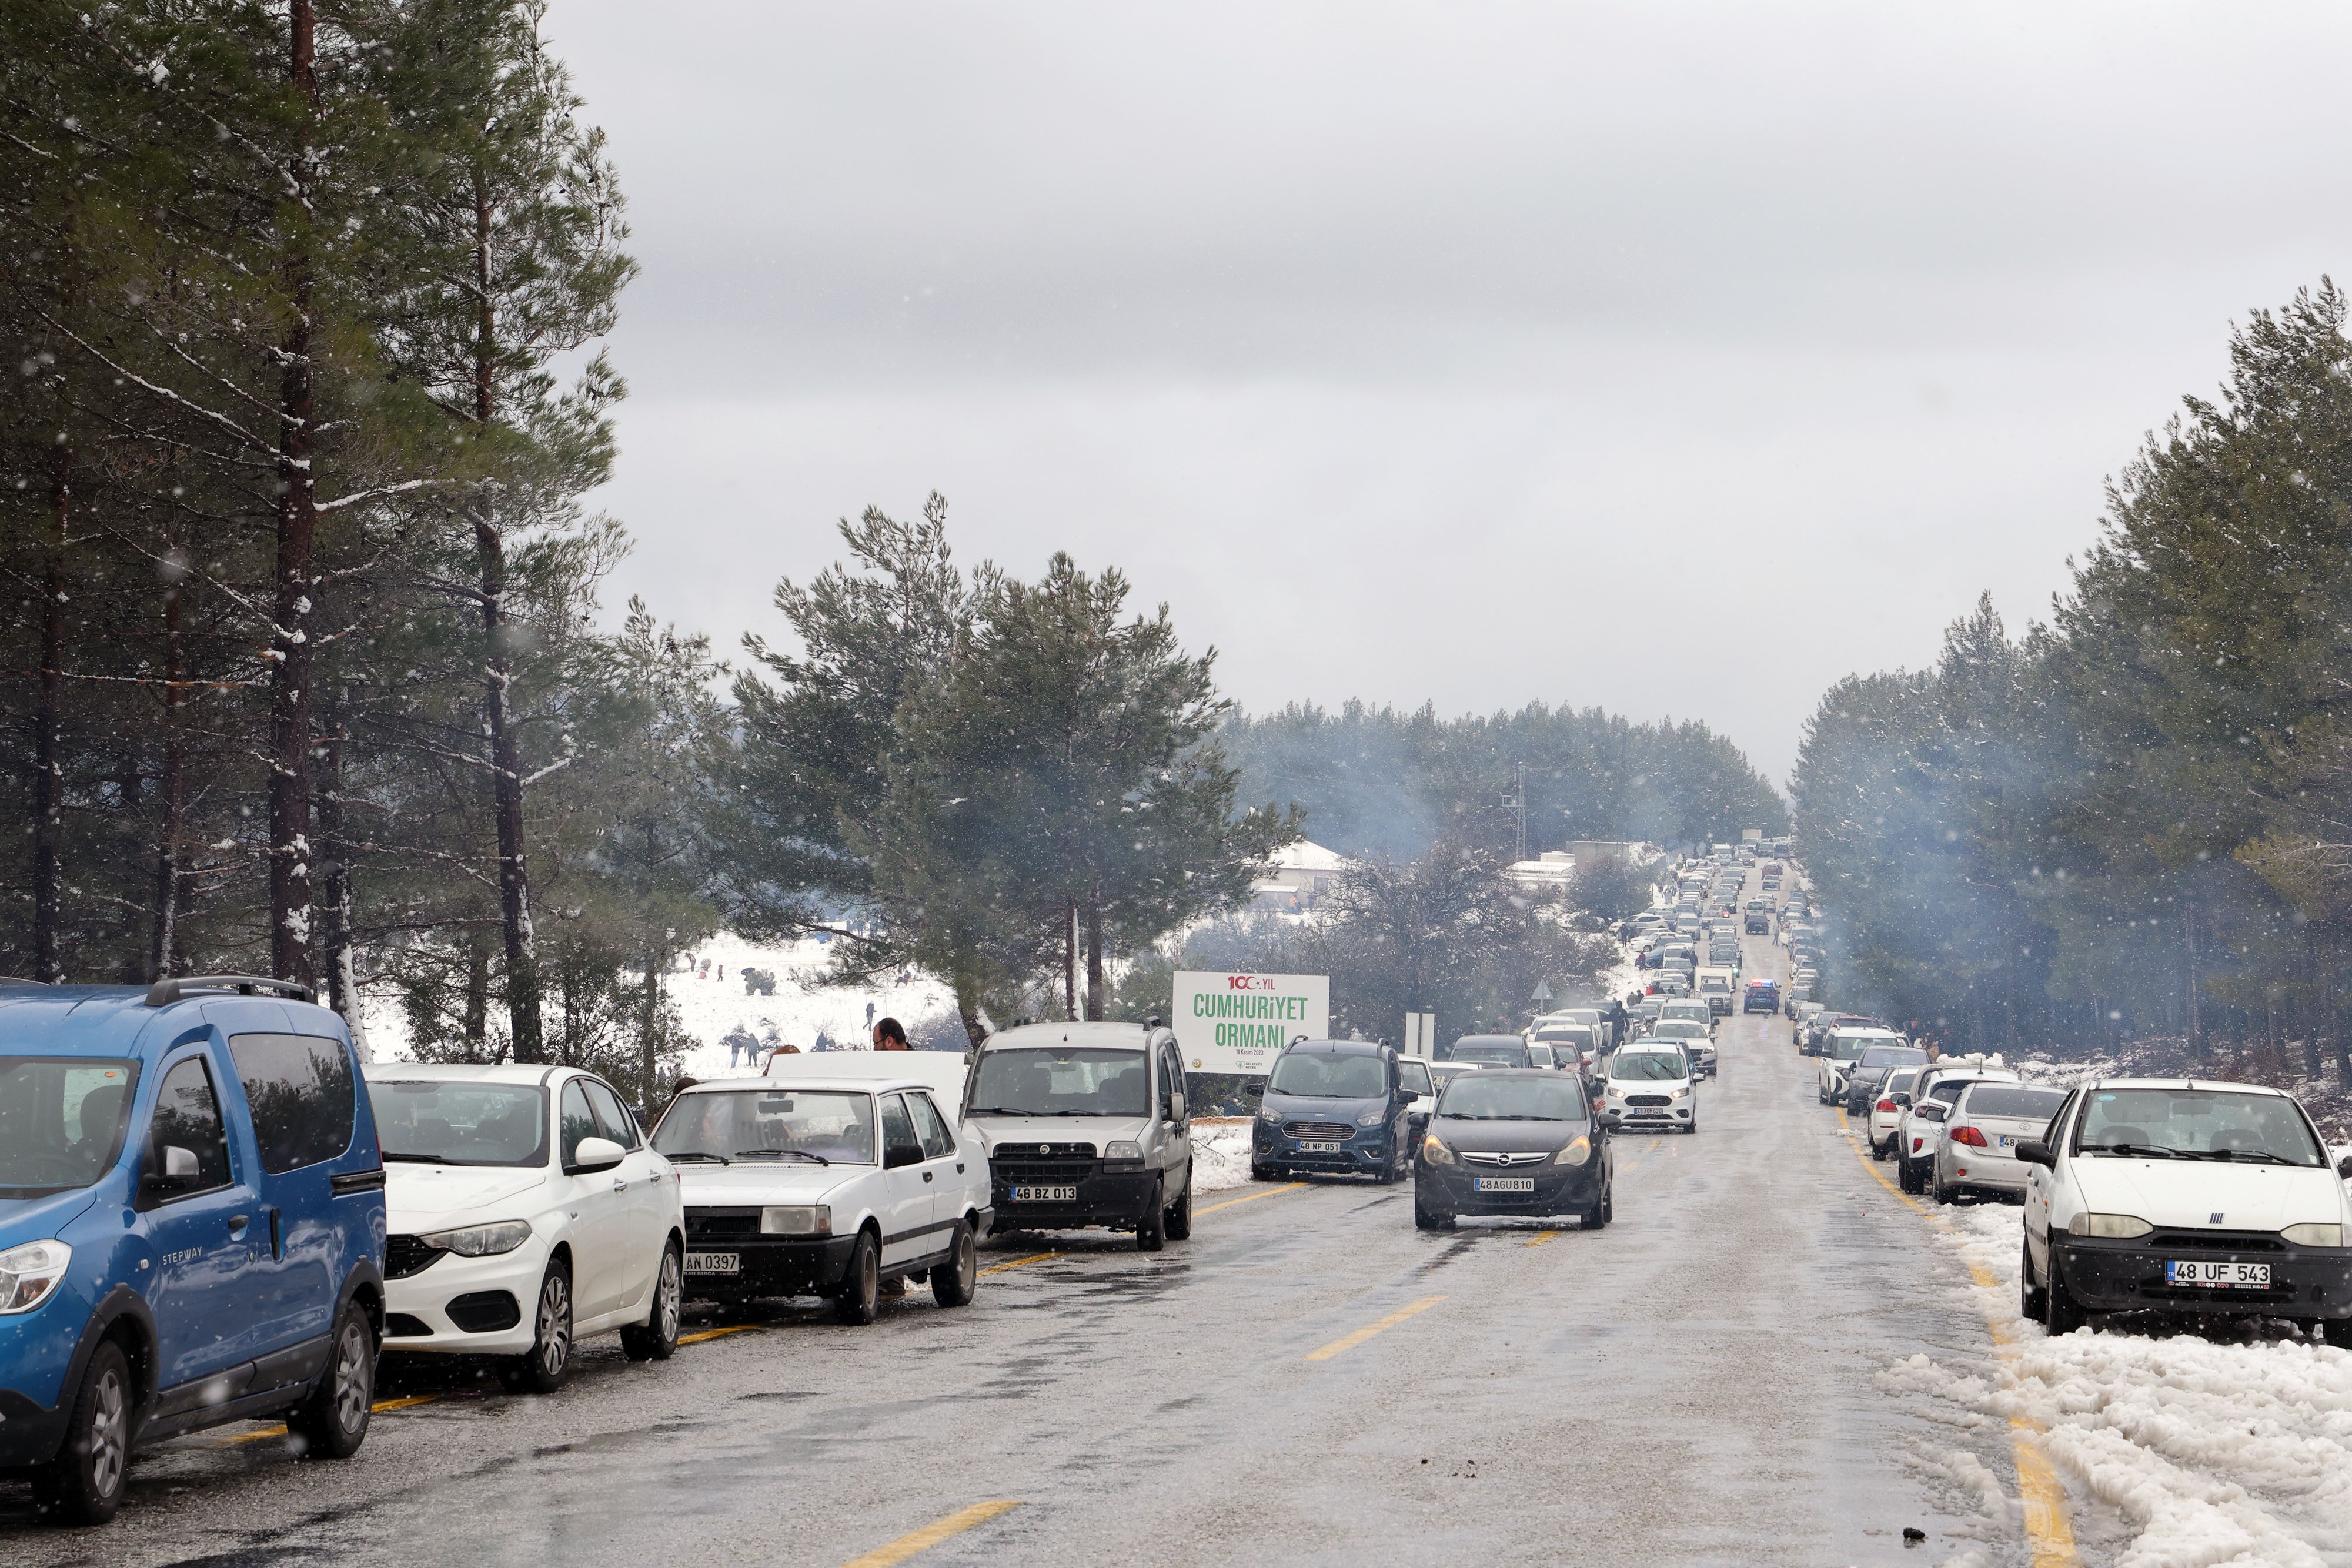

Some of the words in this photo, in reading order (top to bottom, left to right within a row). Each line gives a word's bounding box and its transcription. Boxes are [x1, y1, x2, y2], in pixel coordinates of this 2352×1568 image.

[1215, 1022, 1285, 1048] ORMANI
[2004, 1138, 2015, 1146] 48
[1016, 1188, 1030, 1199] 48
[1035, 1188, 1049, 1199] BZ
[1054, 1188, 1075, 1199] 013
[162, 1246, 202, 1265] STEPWAY
[686, 1256, 701, 1269] AN
[706, 1255, 737, 1269] 0397
[2177, 1263, 2196, 1279] 48
[2205, 1264, 2229, 1280] UF
[2237, 1266, 2269, 1281] 543
